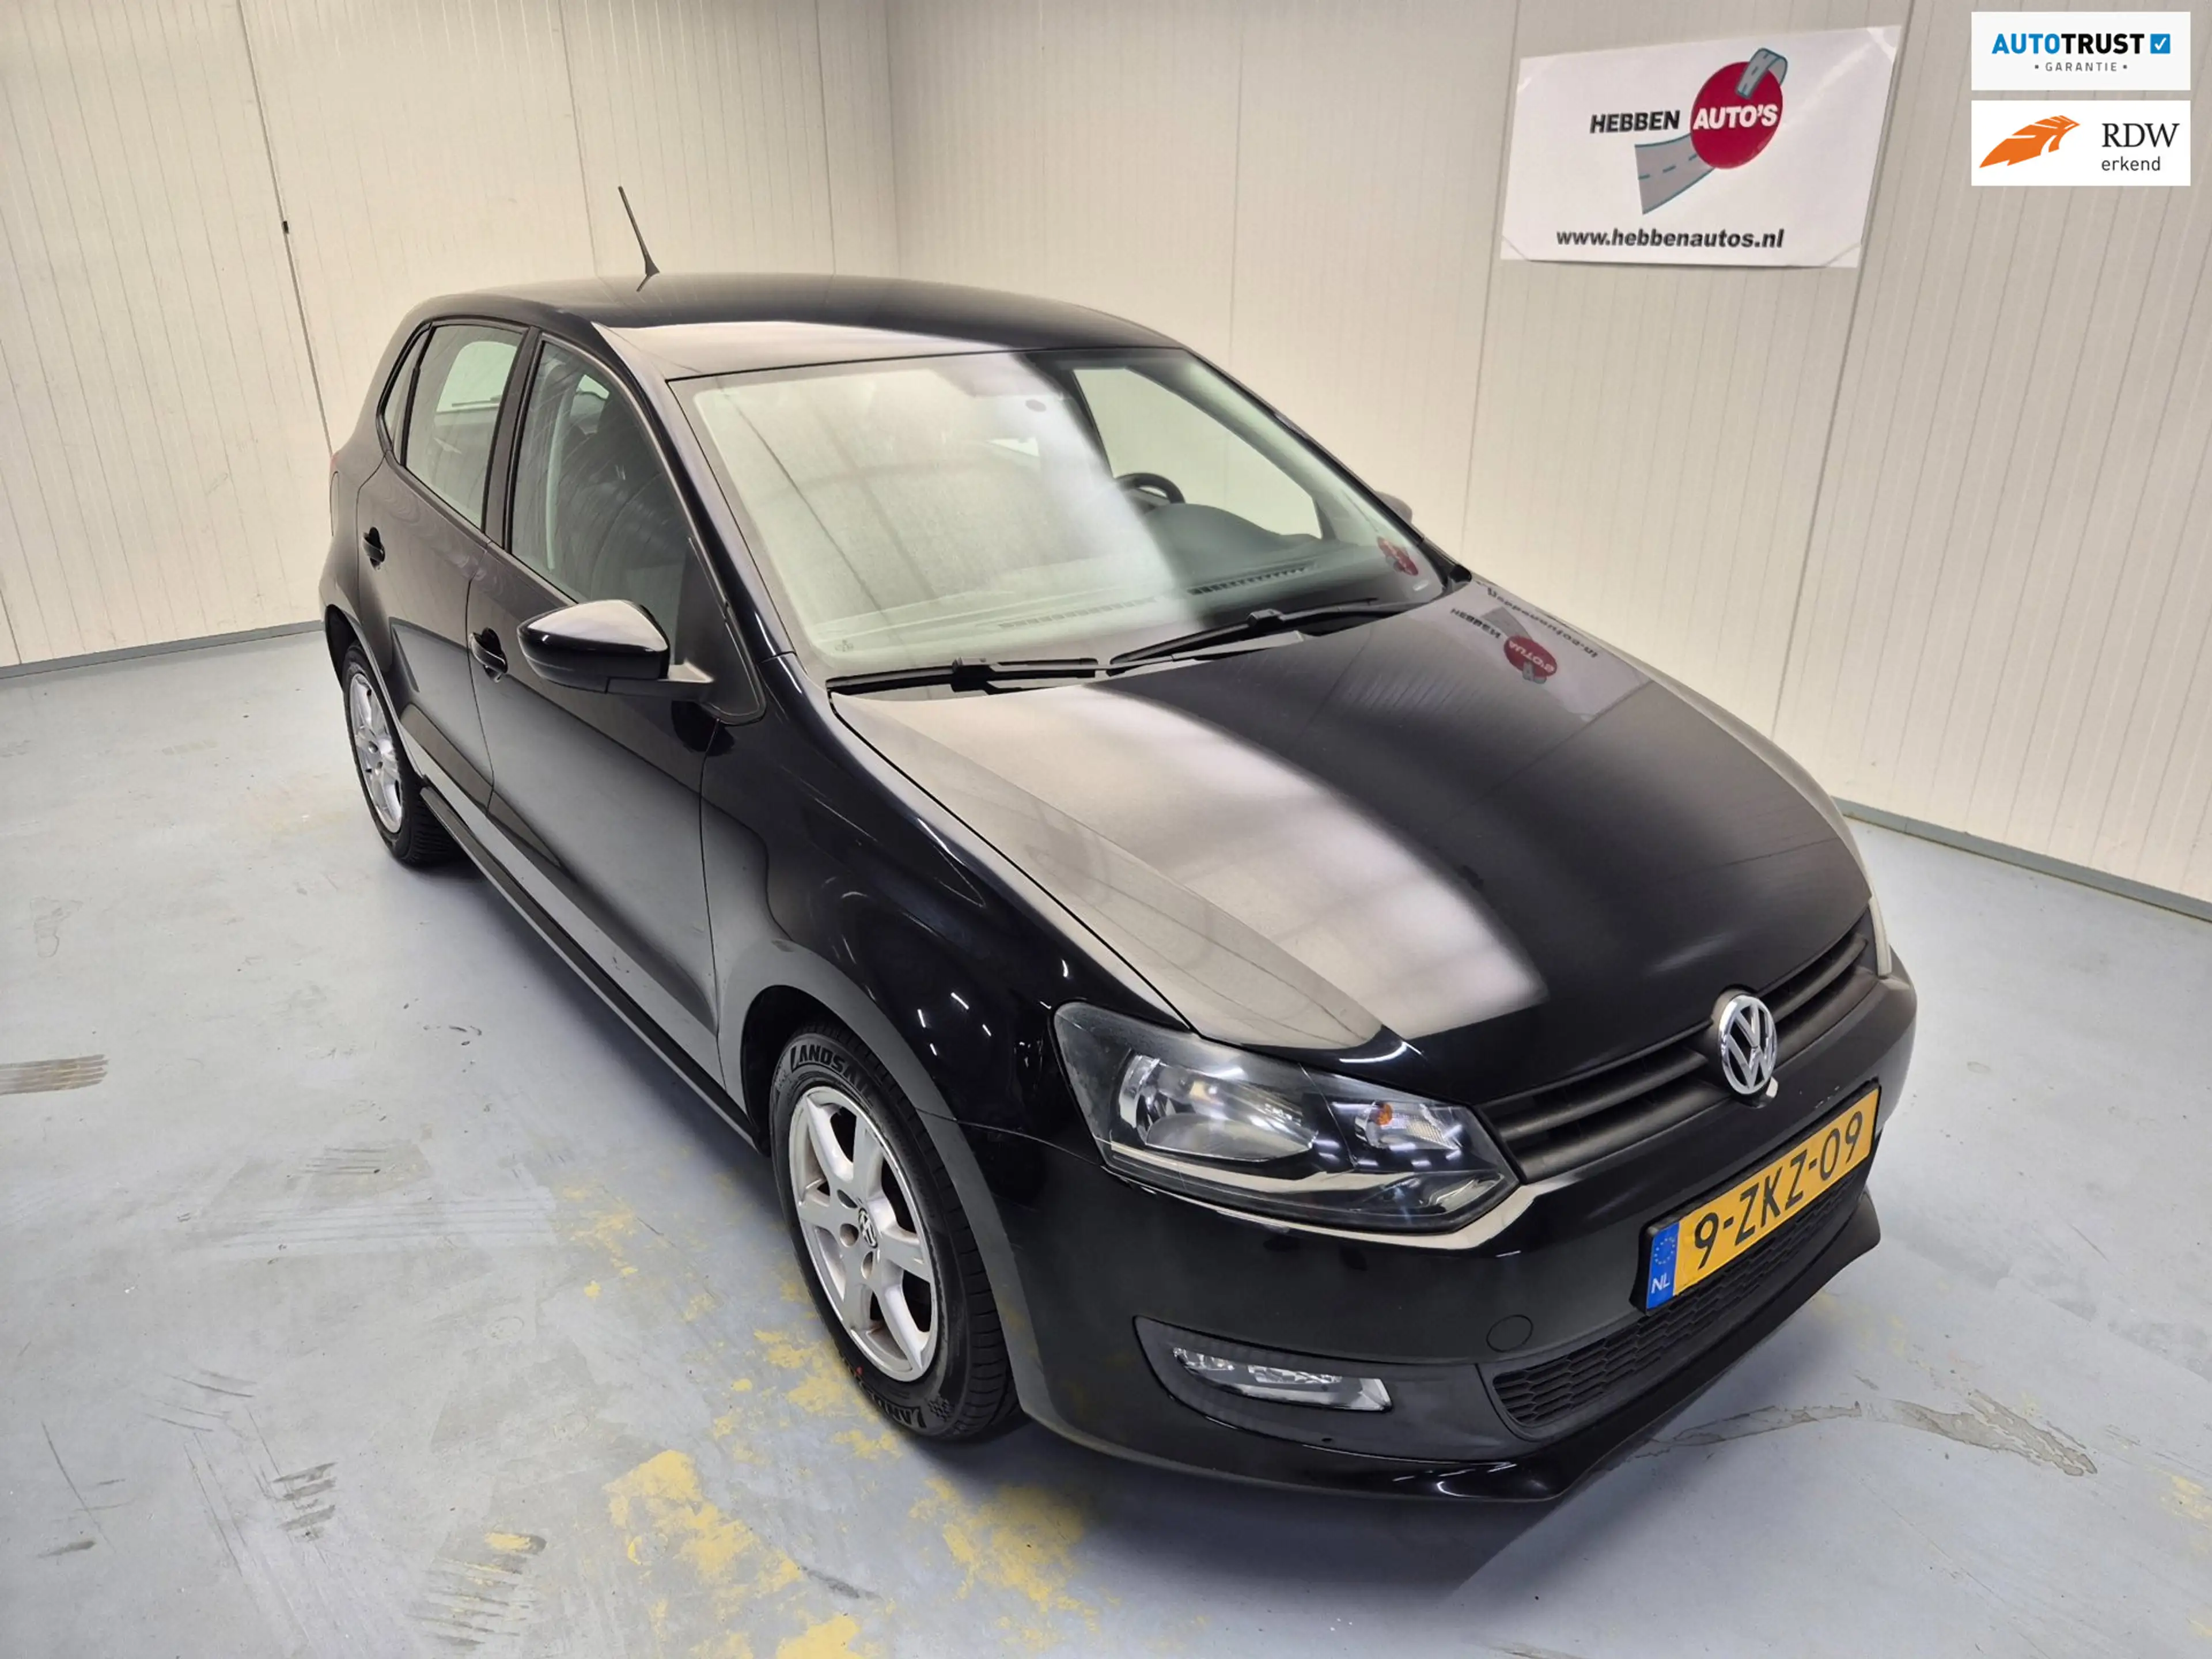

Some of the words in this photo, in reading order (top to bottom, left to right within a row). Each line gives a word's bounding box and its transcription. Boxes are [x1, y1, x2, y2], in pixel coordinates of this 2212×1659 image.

[1589, 111, 1680, 133] HEBBEN
[1692, 104, 1778, 130] AUTO'S
[1556, 229, 1785, 248] www.hebbenautos.nl
[1694, 1111, 1863, 1271] 9-ZKZ-09
[1651, 1274, 1671, 1294] NL
